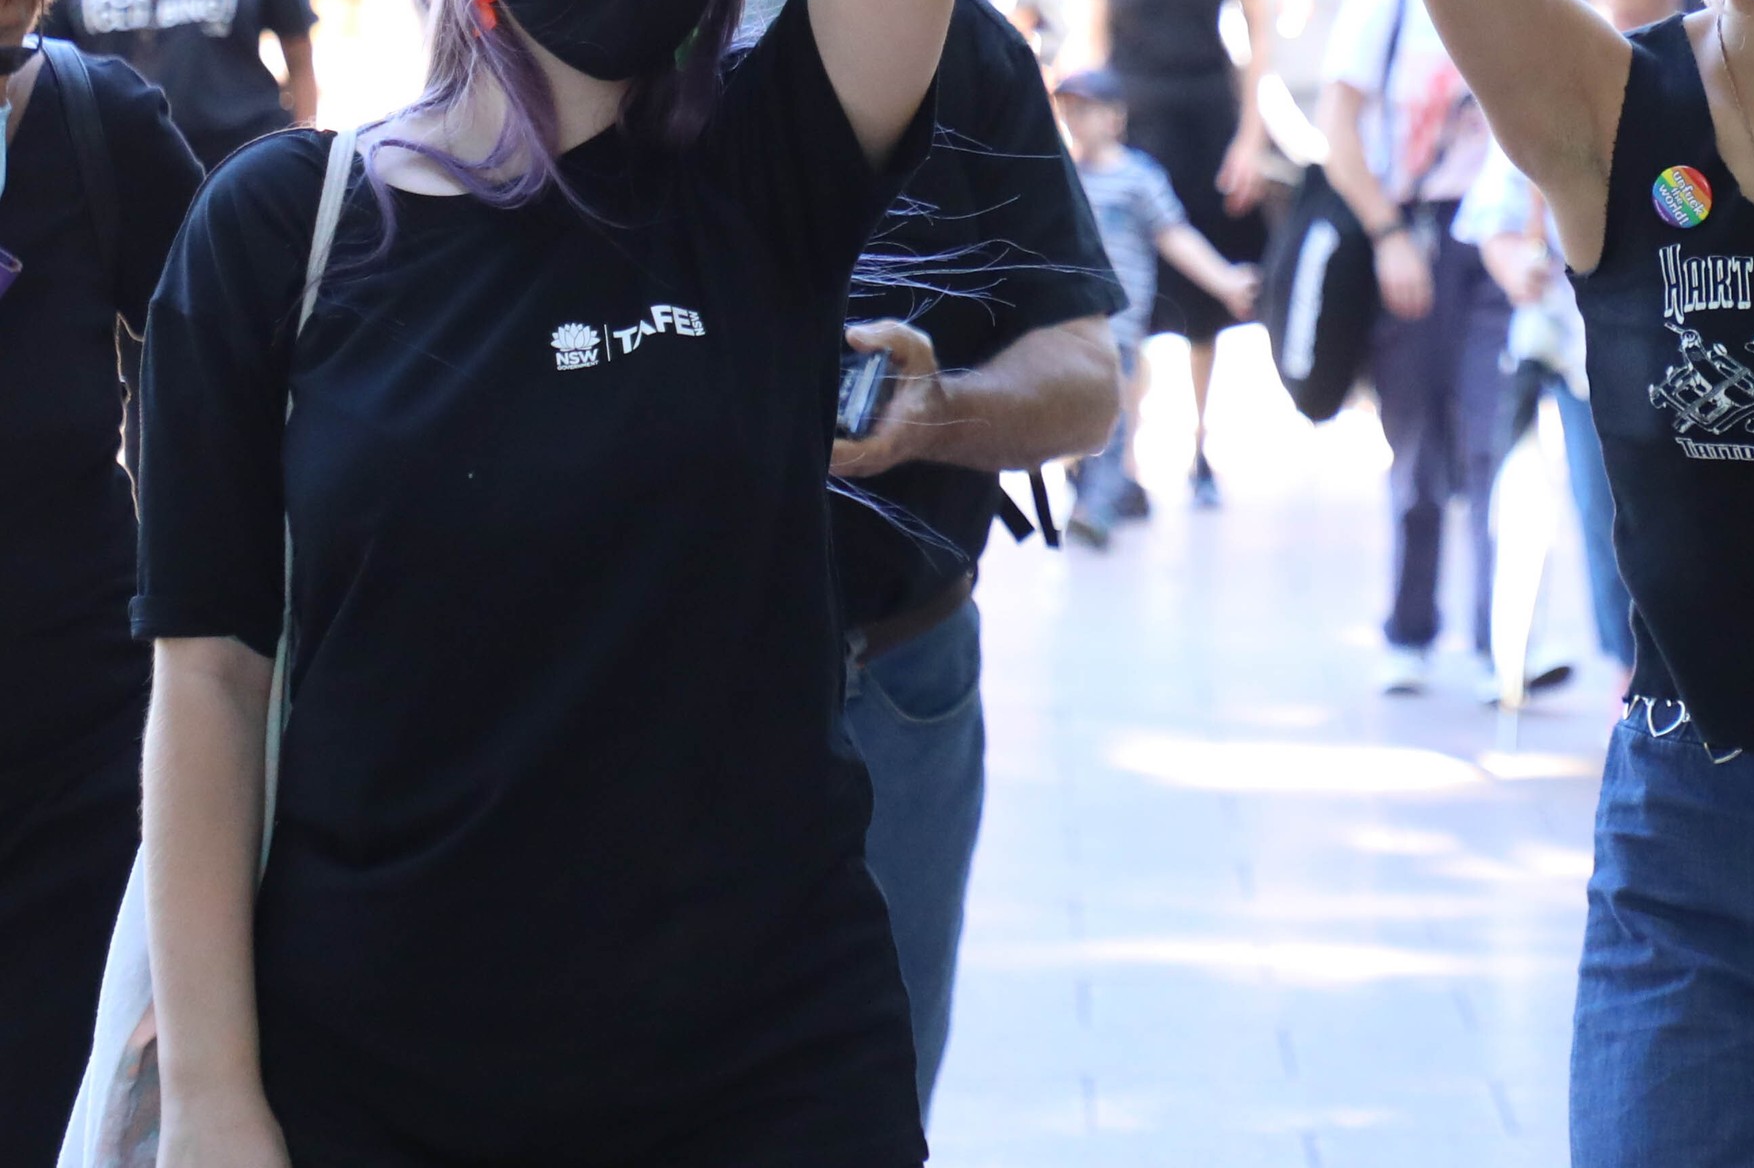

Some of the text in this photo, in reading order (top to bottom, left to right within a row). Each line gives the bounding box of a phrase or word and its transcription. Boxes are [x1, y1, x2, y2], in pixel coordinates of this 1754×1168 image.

[1659, 183, 1690, 226] world!
[1671, 187, 1683, 205] the
[1672, 171, 1705, 216] unfuck
[1659, 243, 1754, 325] HART
[613, 304, 697, 355] TAFE
[688, 311, 706, 337] NSW
[555, 348, 599, 366] NSW
